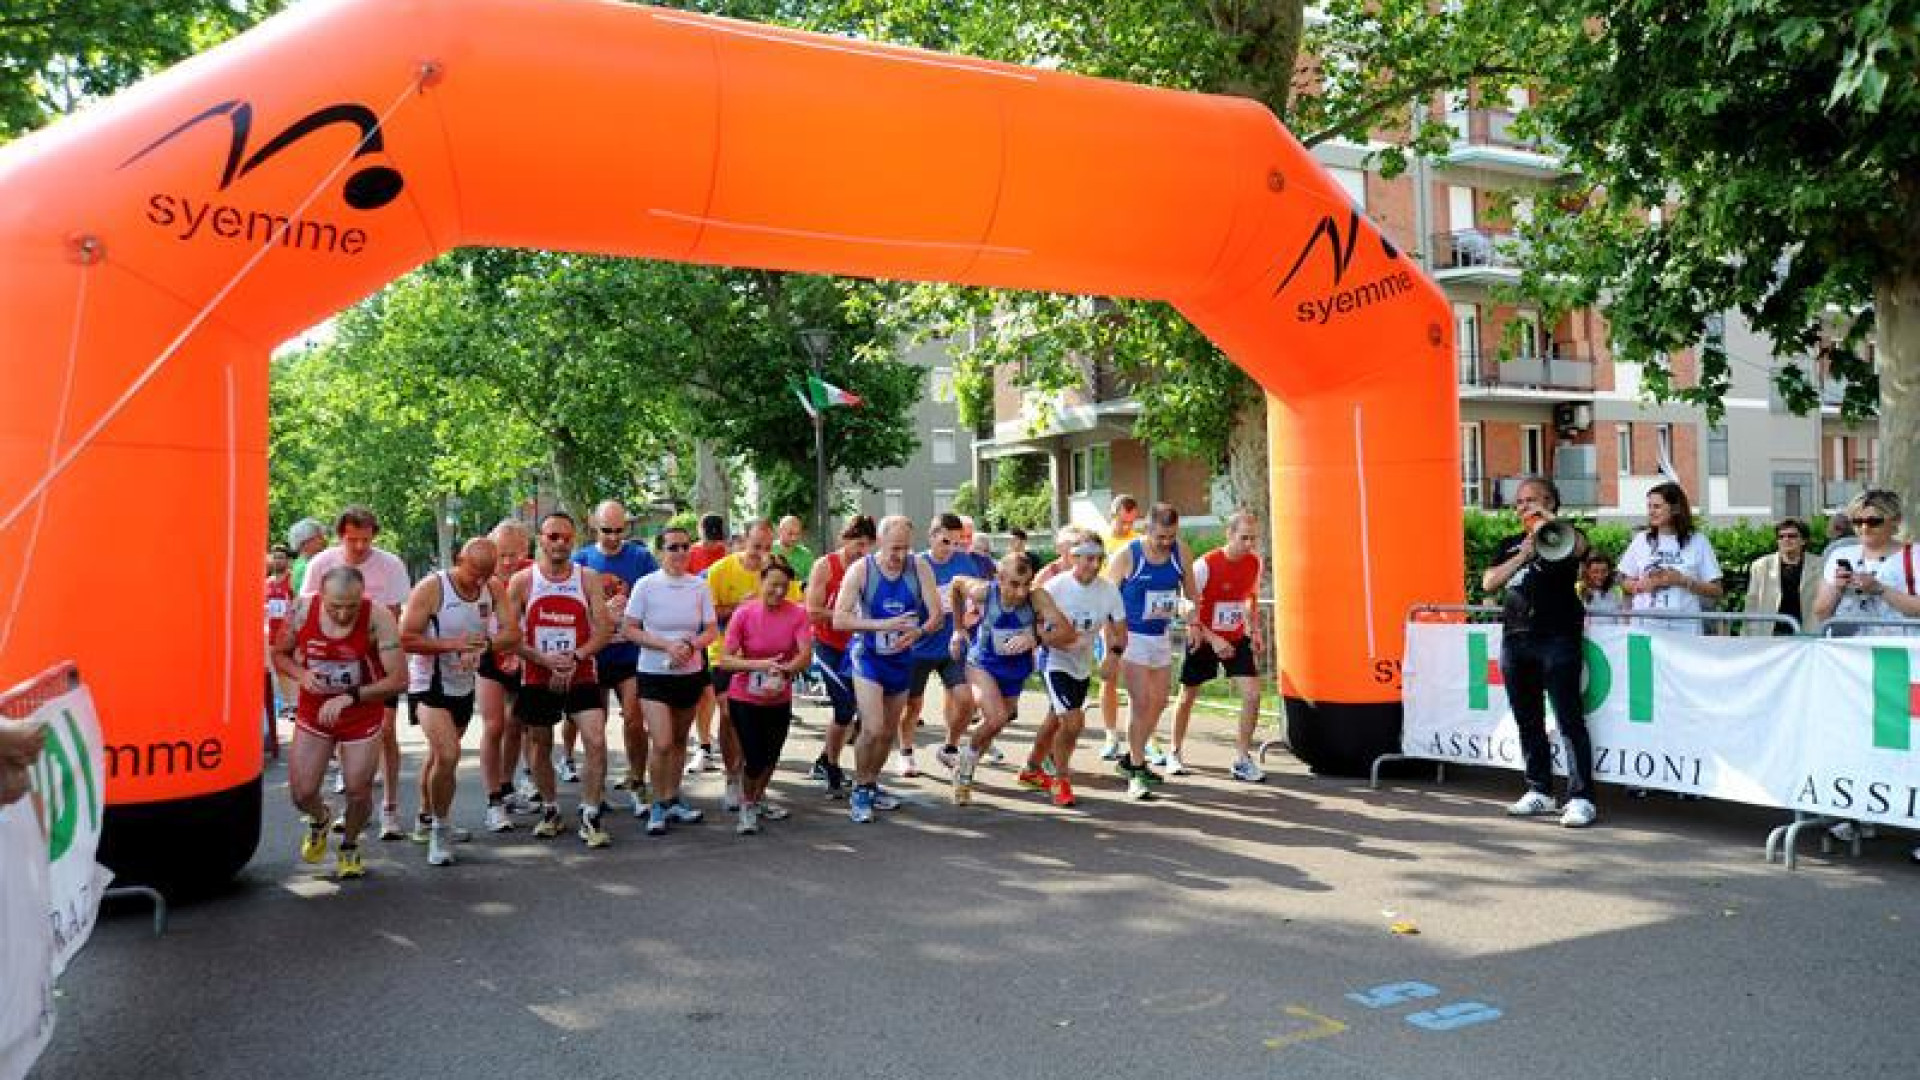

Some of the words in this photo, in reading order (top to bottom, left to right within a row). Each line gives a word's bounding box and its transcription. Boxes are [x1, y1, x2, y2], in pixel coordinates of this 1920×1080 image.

[147, 193, 368, 255] syemme
[1296, 270, 1415, 325] syemme
[1428, 731, 1702, 786] ASSICRZIONI
